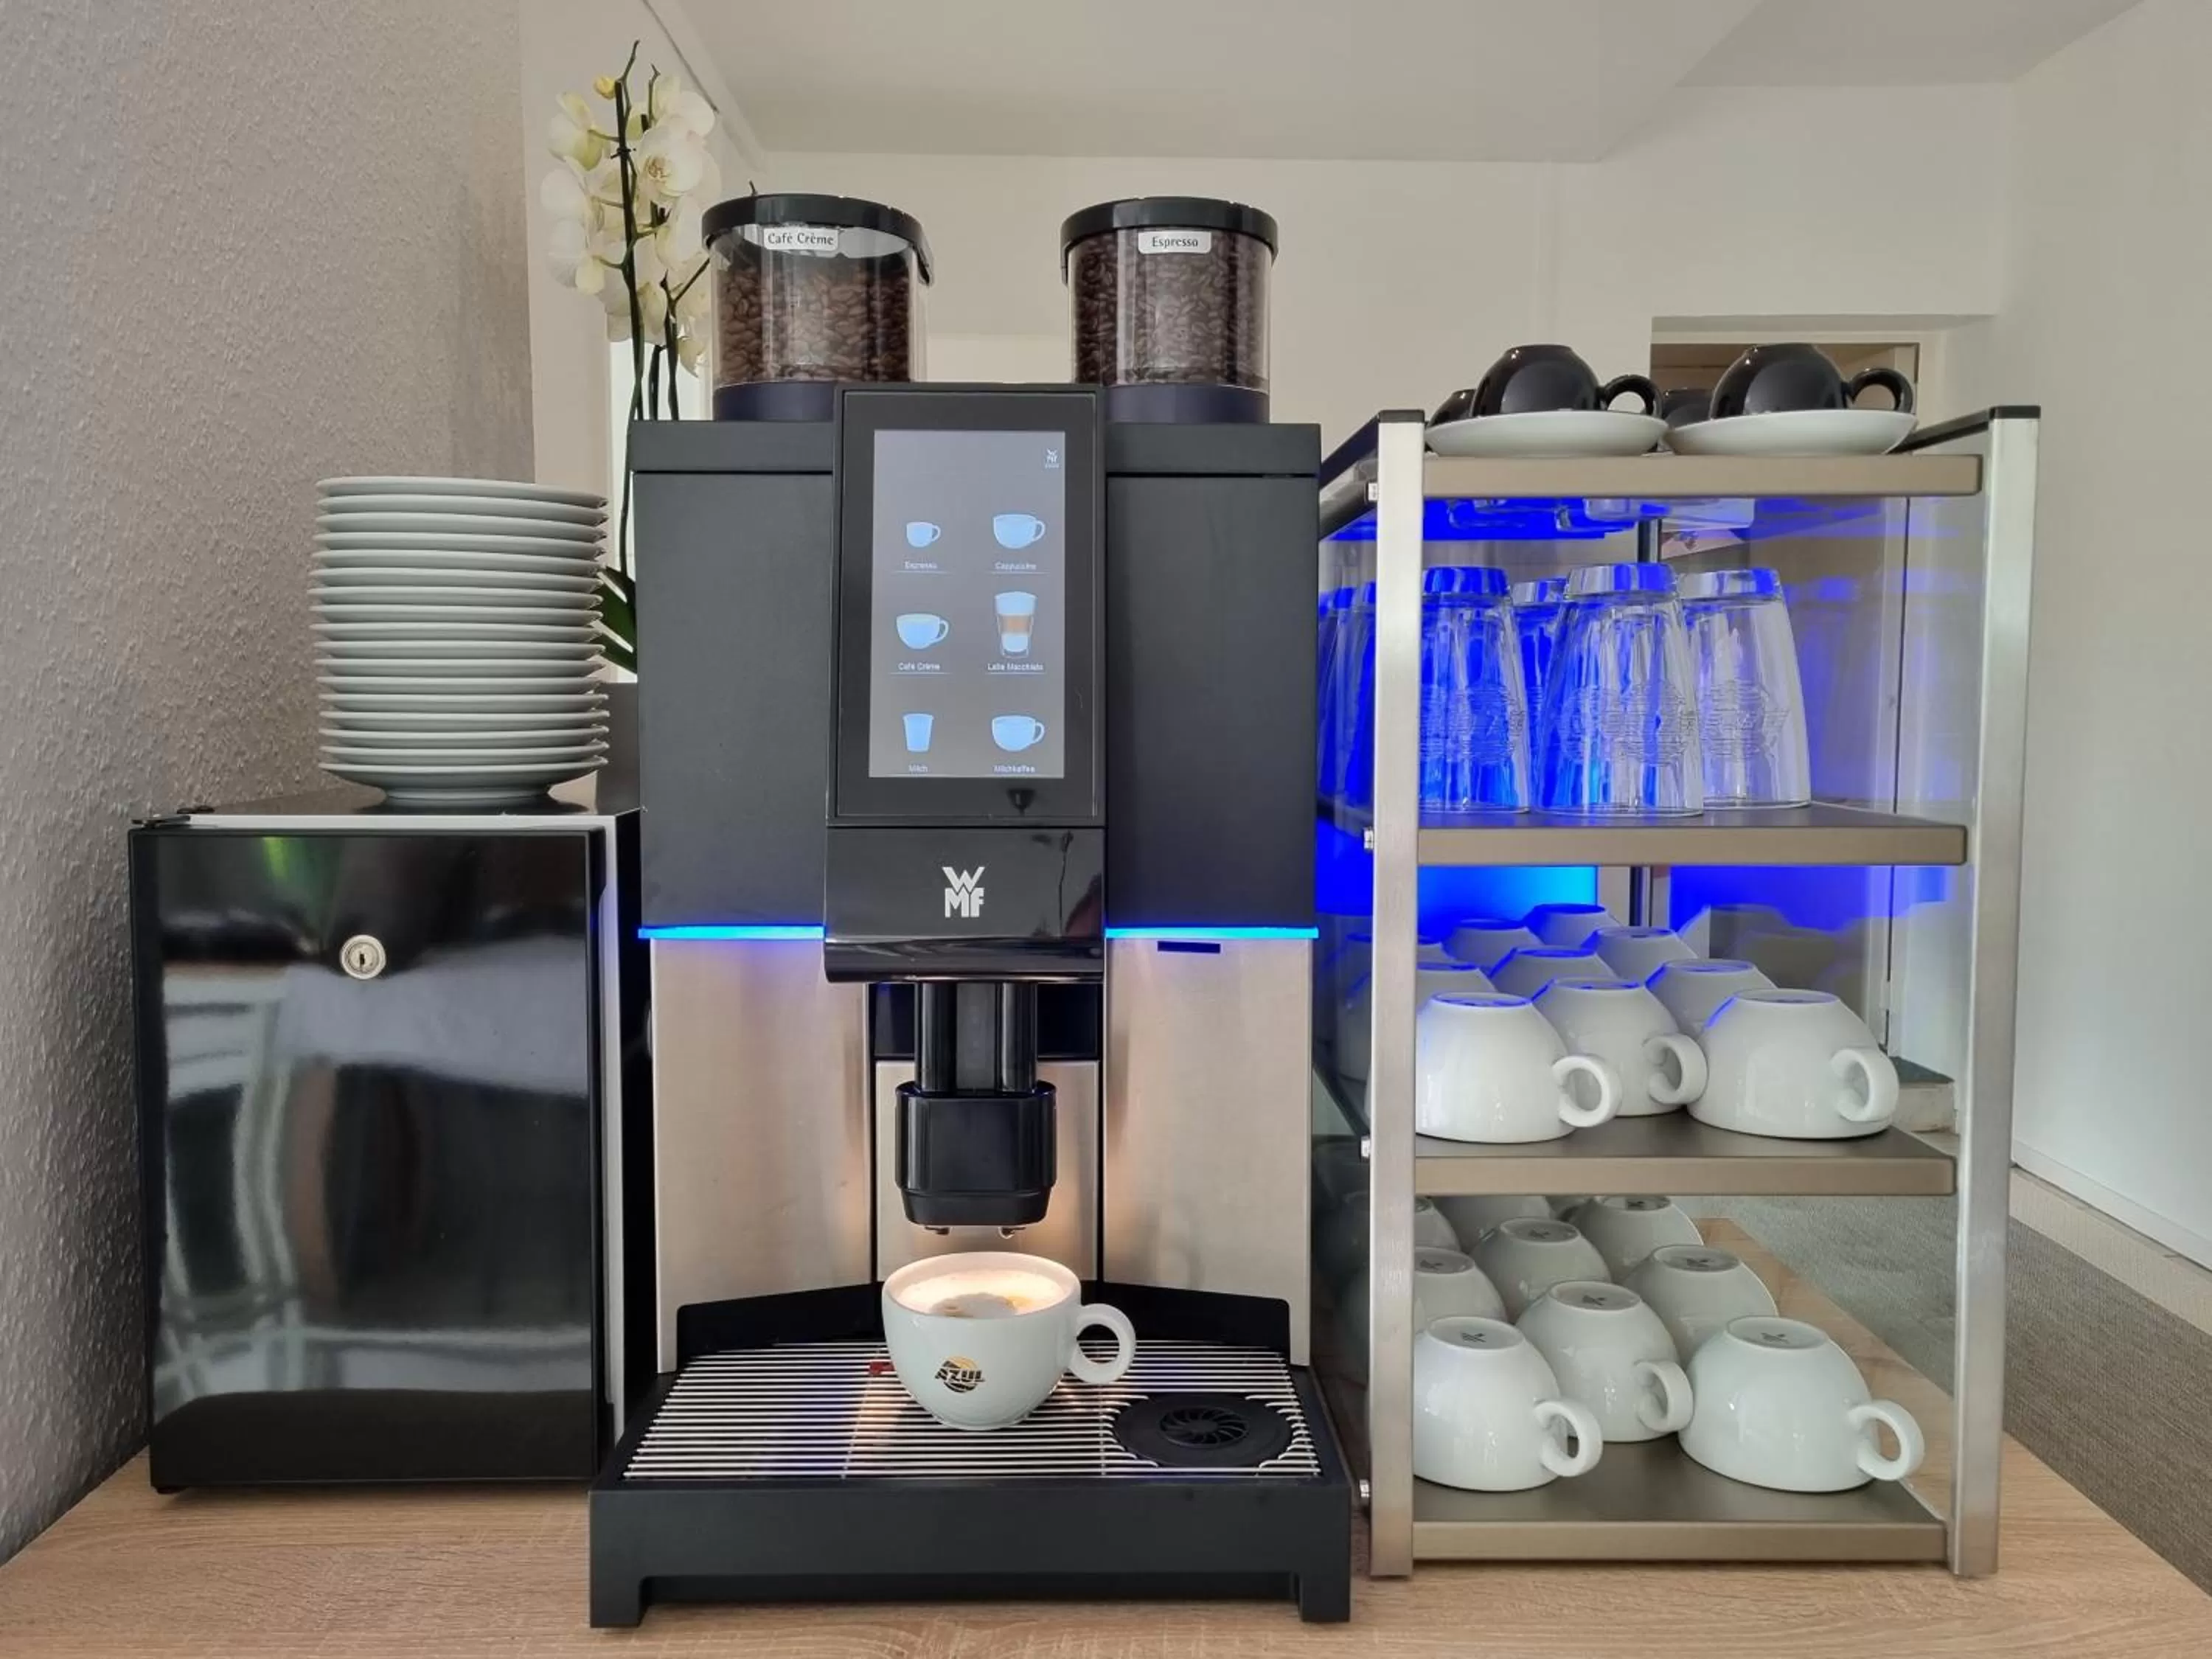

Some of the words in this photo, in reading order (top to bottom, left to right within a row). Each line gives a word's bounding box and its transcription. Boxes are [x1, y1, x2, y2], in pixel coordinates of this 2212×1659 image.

[768, 232, 792, 244] Café
[797, 232, 834, 245] Crème
[1152, 236, 1198, 248] Espresso
[942, 866, 985, 917] WMF
[934, 1367, 986, 1382] AZUL
